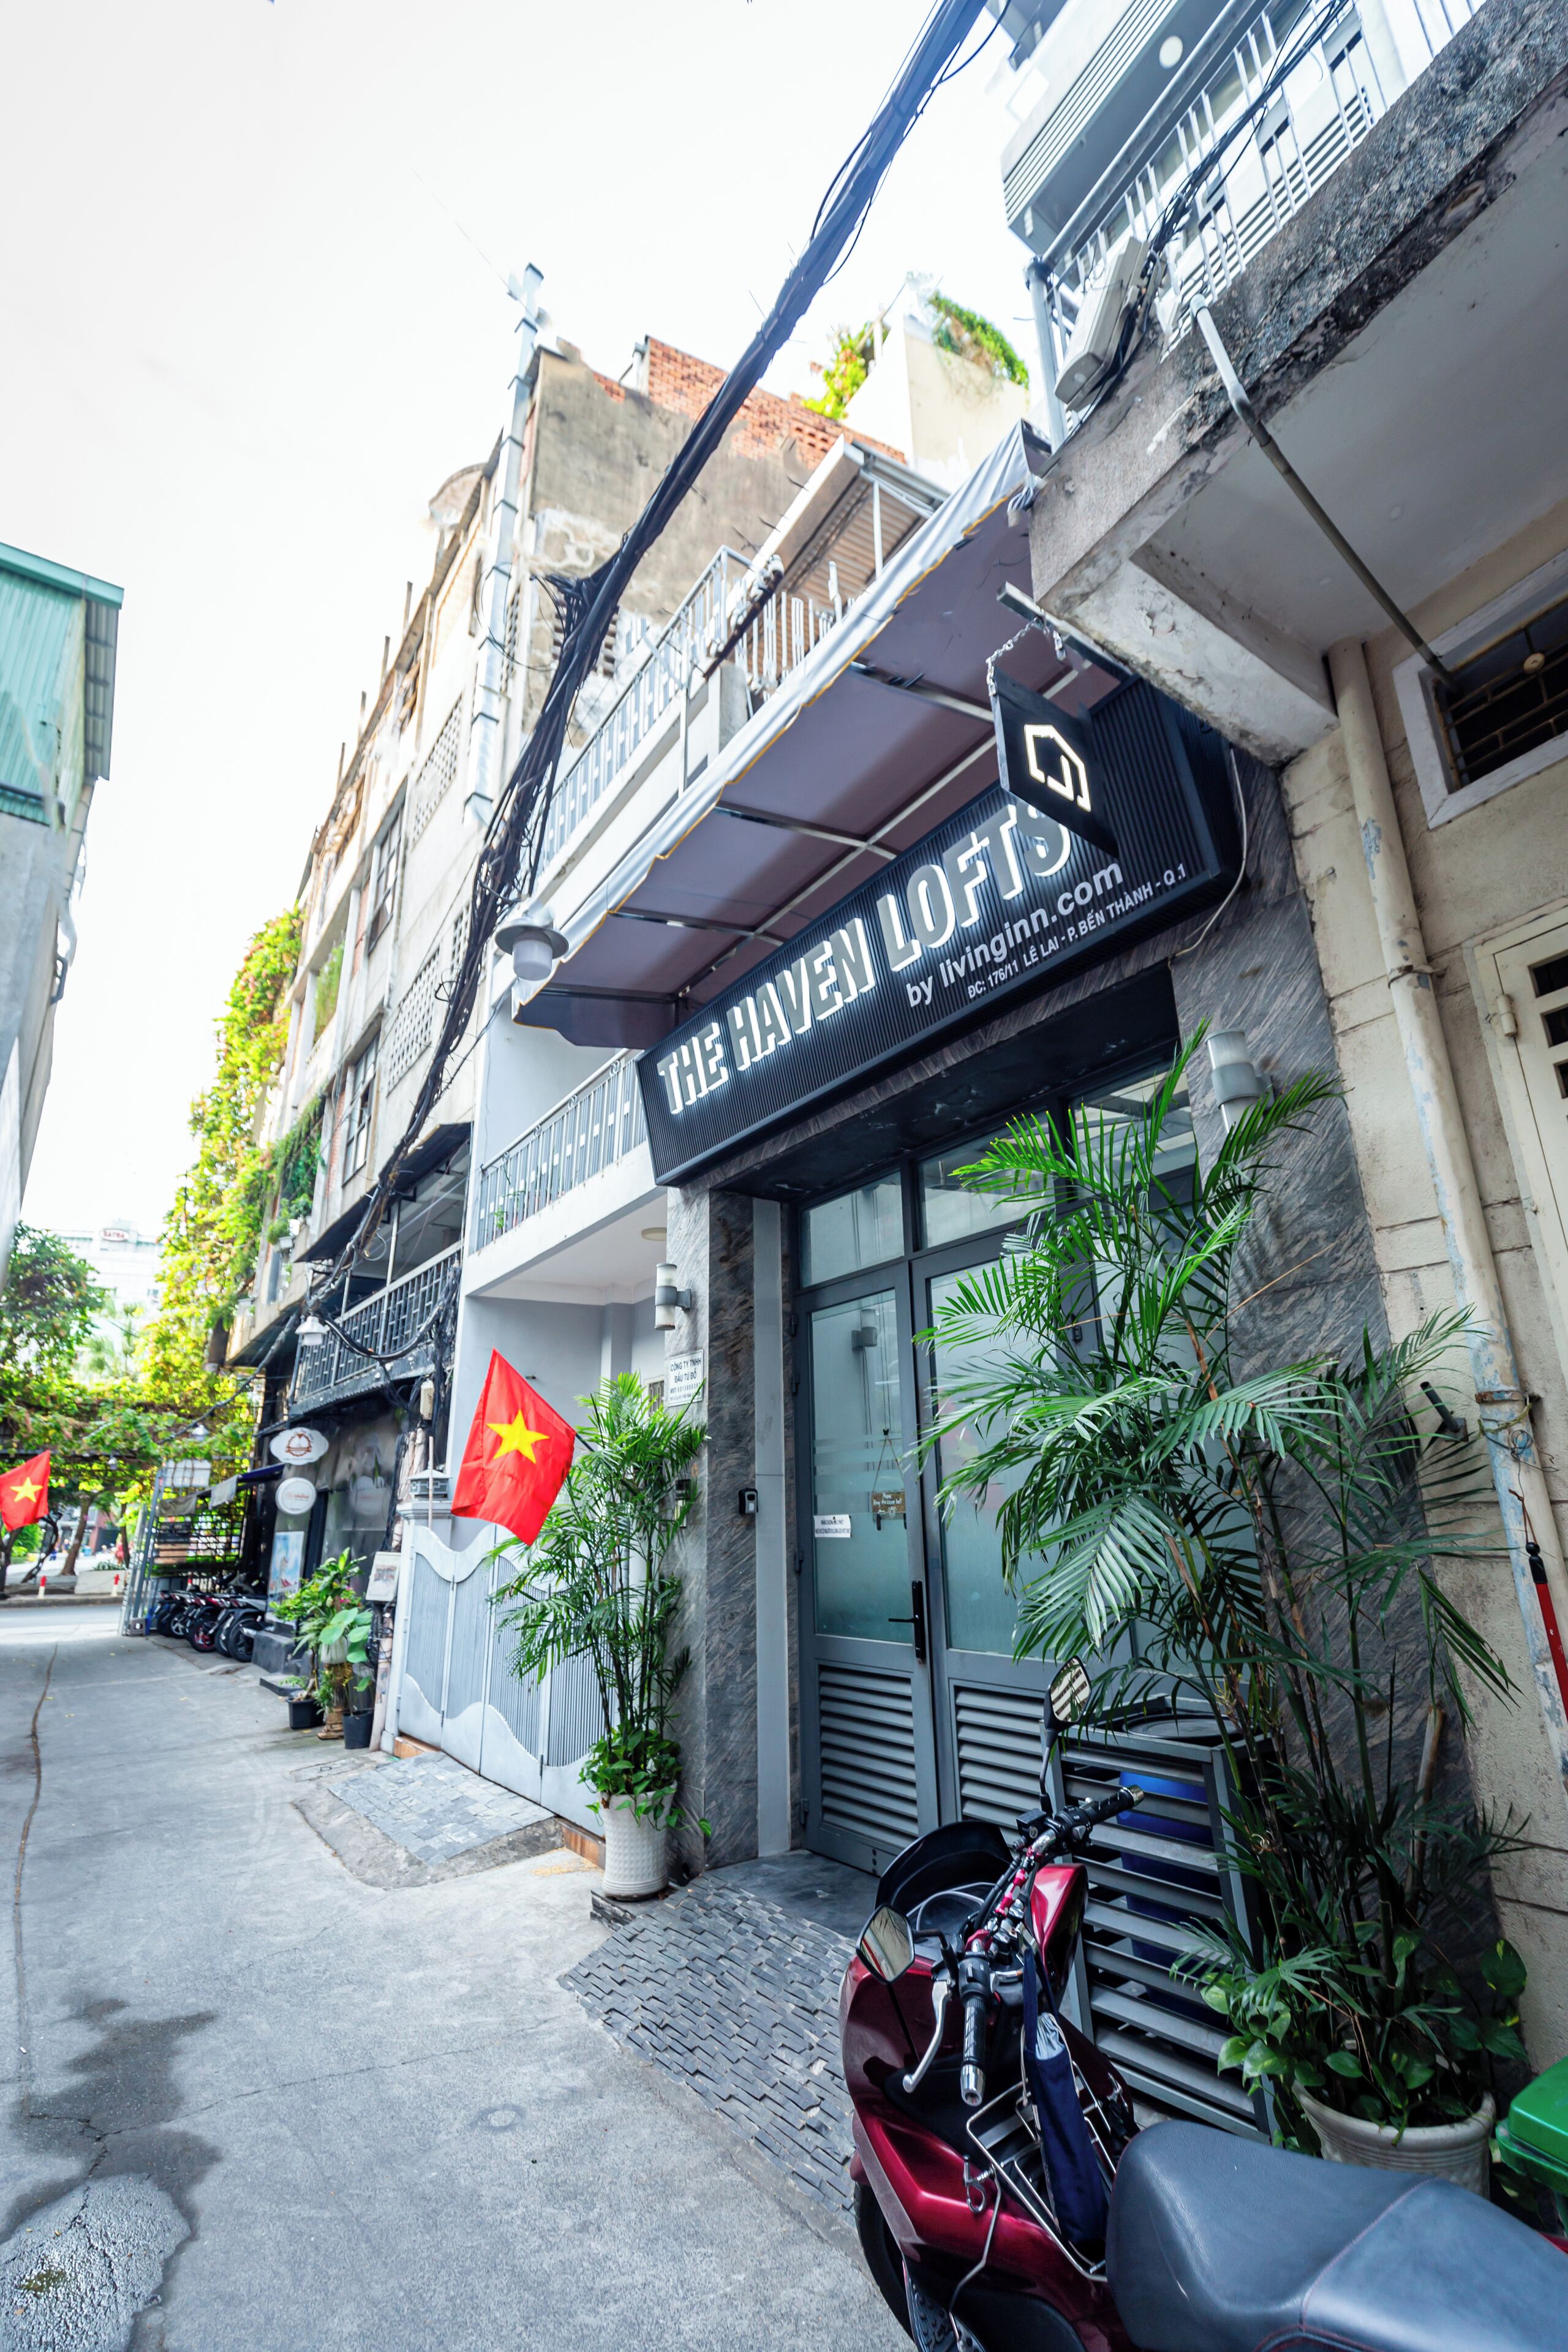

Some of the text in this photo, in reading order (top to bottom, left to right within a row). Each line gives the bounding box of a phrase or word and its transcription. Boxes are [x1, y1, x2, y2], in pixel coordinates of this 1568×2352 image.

[657, 801, 1071, 1115] THE HAVEN LOFTS
[906, 862, 1125, 1008] by livinginn.com
[988, 959, 1019, 987] 176/11
[1023, 945, 1039, 967] LÊ
[1040, 936, 1059, 957] LAI
[1106, 881, 1153, 919] THÀNH
[690, 1357, 701, 1366] TNHH
